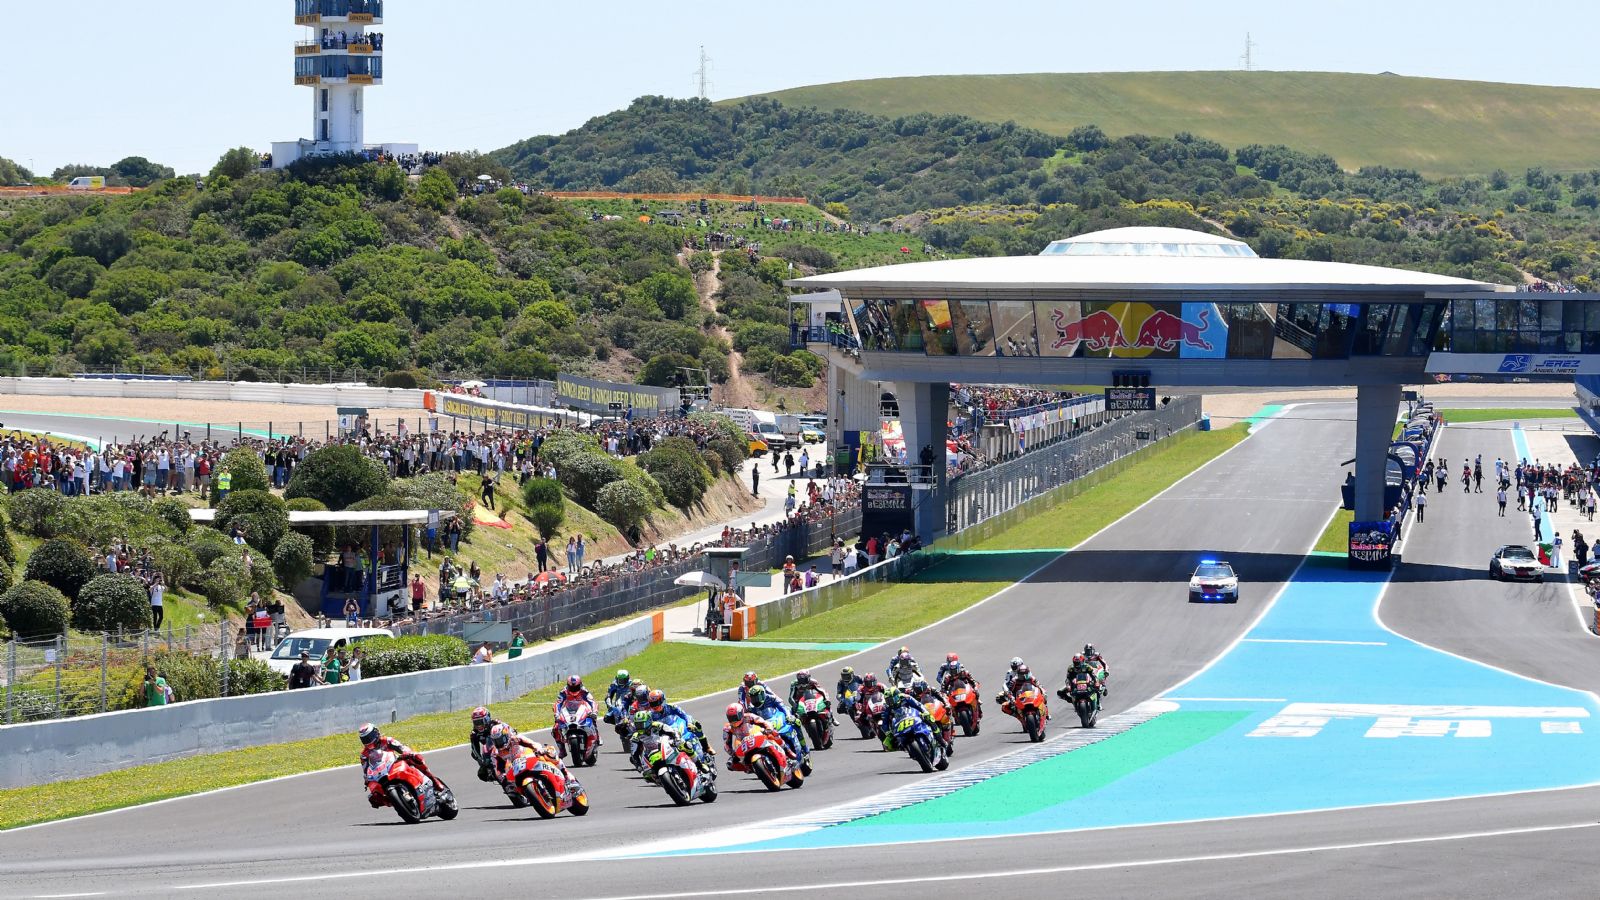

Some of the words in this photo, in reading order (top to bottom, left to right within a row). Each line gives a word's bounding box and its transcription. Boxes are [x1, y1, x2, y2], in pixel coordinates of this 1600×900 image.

[1535, 360, 1581, 368] JEREZ
[578, 385, 590, 401] BEER
[342, 418, 347, 426] 4
[896, 718, 915, 732] 46
[741, 736, 755, 751] 93
